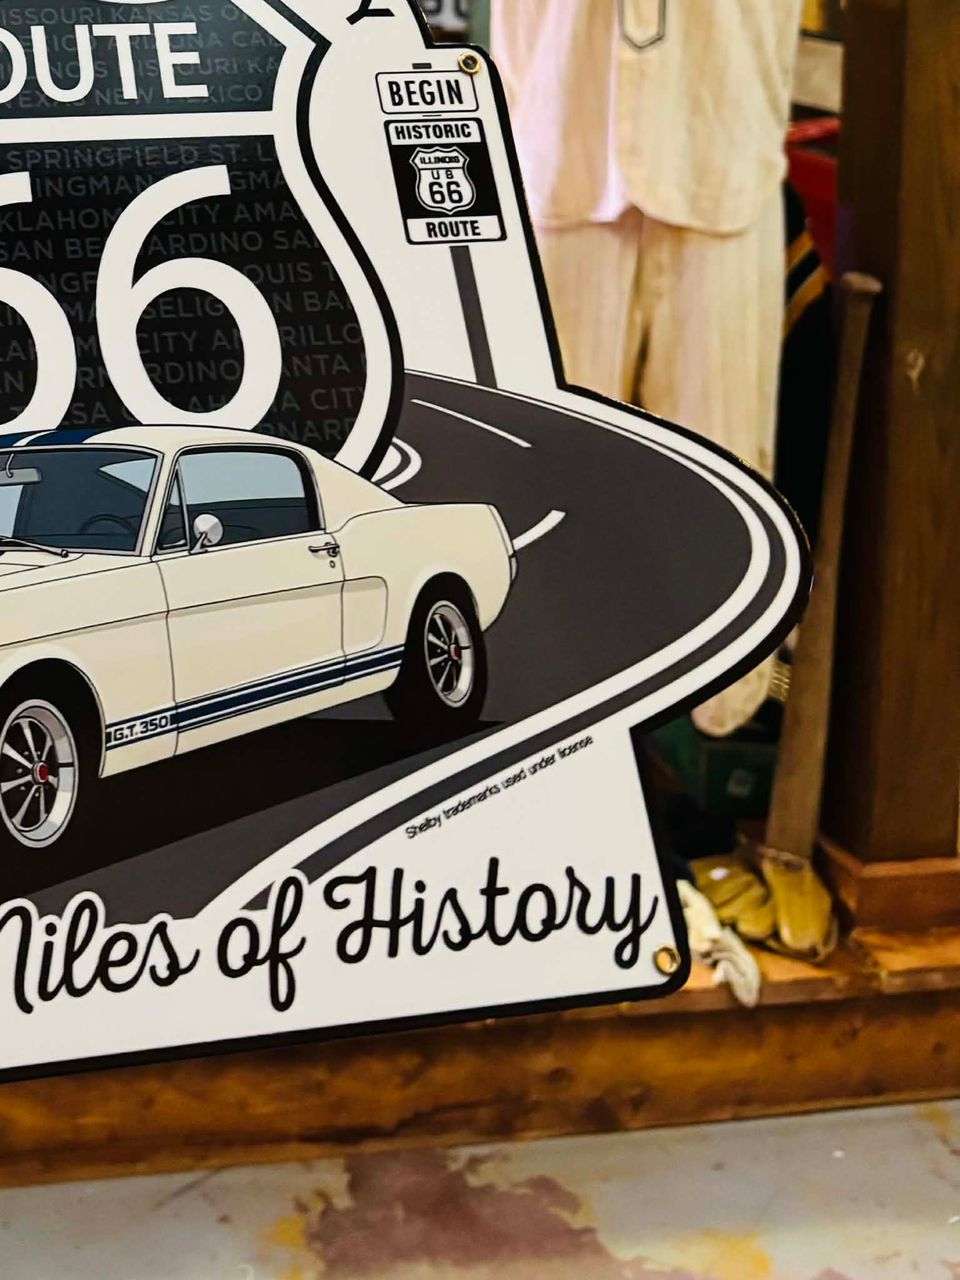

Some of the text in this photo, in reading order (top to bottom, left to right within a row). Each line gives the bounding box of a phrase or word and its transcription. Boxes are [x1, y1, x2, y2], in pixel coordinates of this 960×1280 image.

[111, 4, 213, 24] KANSAS
[388, 79, 464, 106] BEGIN
[394, 123, 472, 140] HISTORIC
[6, 144, 198, 170] SPRINGFIELD
[208, 143, 249, 165] ST.
[428, 181, 464, 204] 66
[426, 220, 481, 238] ROUTE
[139, 714, 169, 735] 350
[405, 735, 594, 840] Shelby trademarks used under license
[216, 875, 306, 1012] of
[323, 856, 659, 970] History
